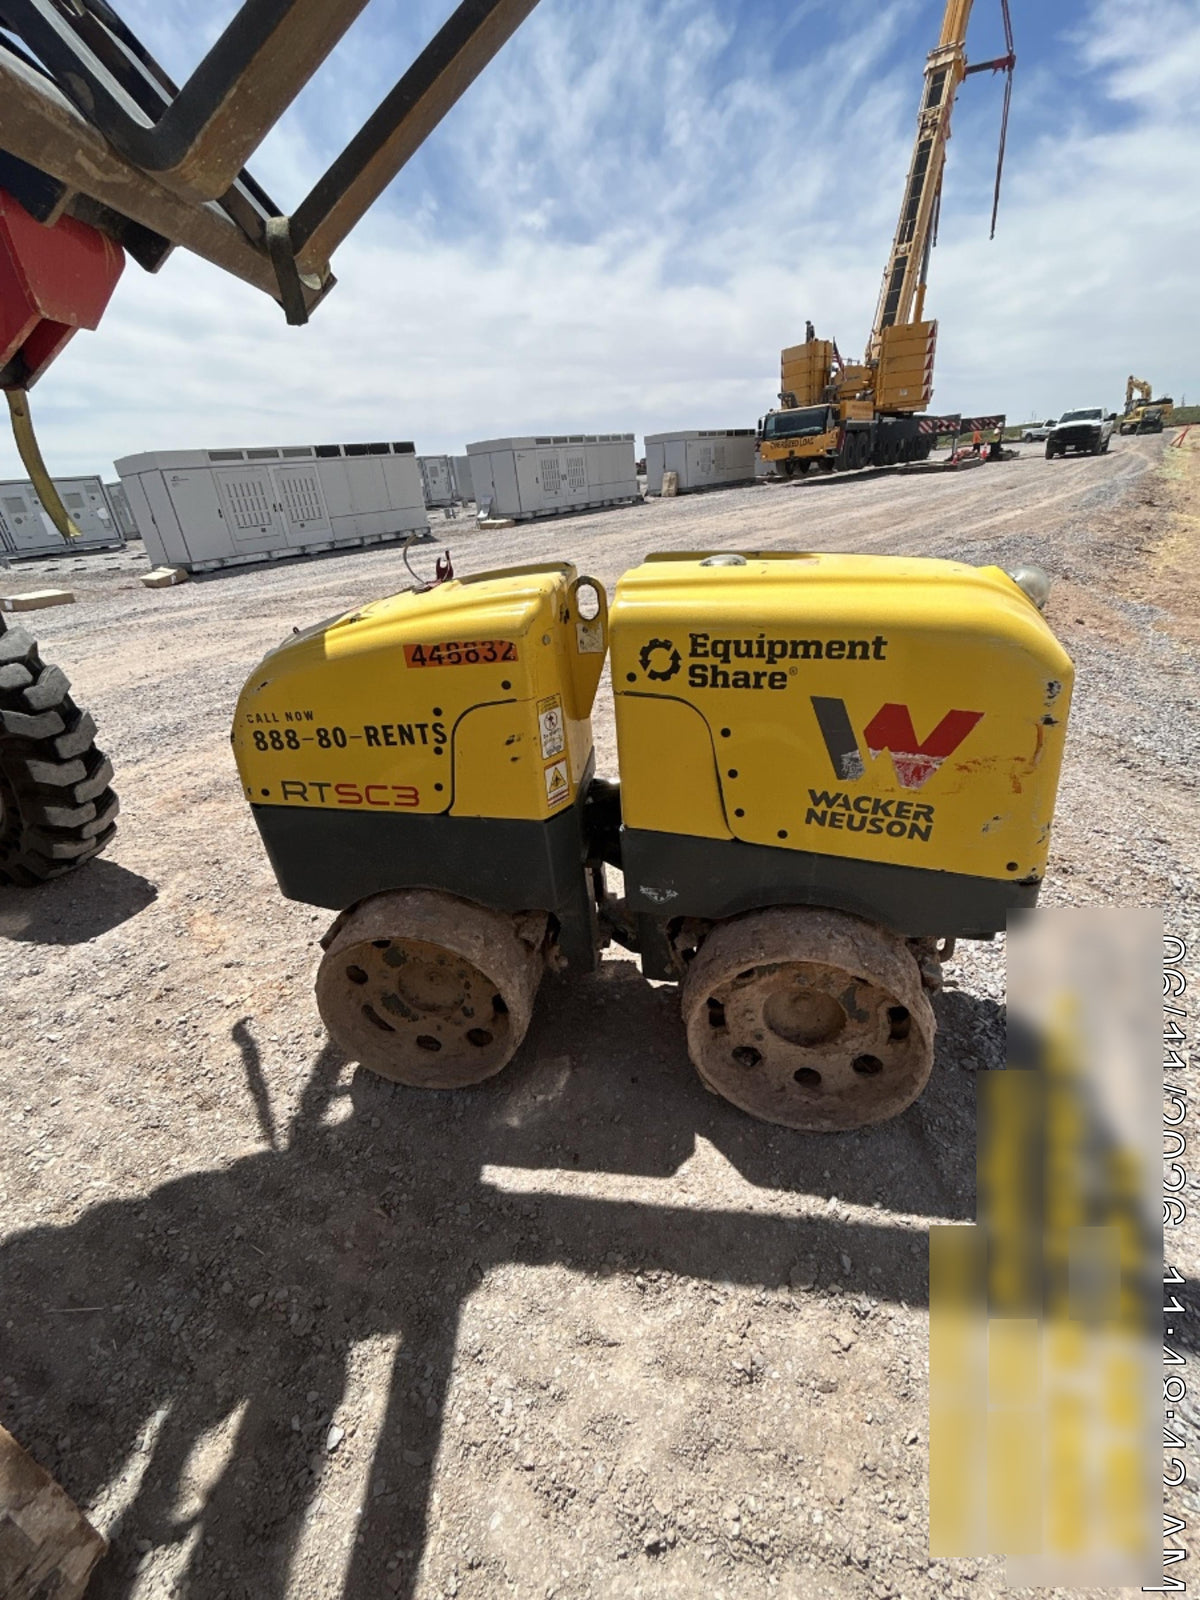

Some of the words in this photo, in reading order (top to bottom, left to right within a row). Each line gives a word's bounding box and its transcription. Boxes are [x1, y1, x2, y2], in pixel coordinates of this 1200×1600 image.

[688, 633, 888, 664] Equipment
[246, 713, 278, 724] CALL
[285, 710, 314, 722] NOW
[253, 722, 447, 751] 888-80-RENTS
[280, 780, 420, 807] RTSC3
[807, 789, 935, 823] WACKER
[804, 808, 932, 842] NEUSON
